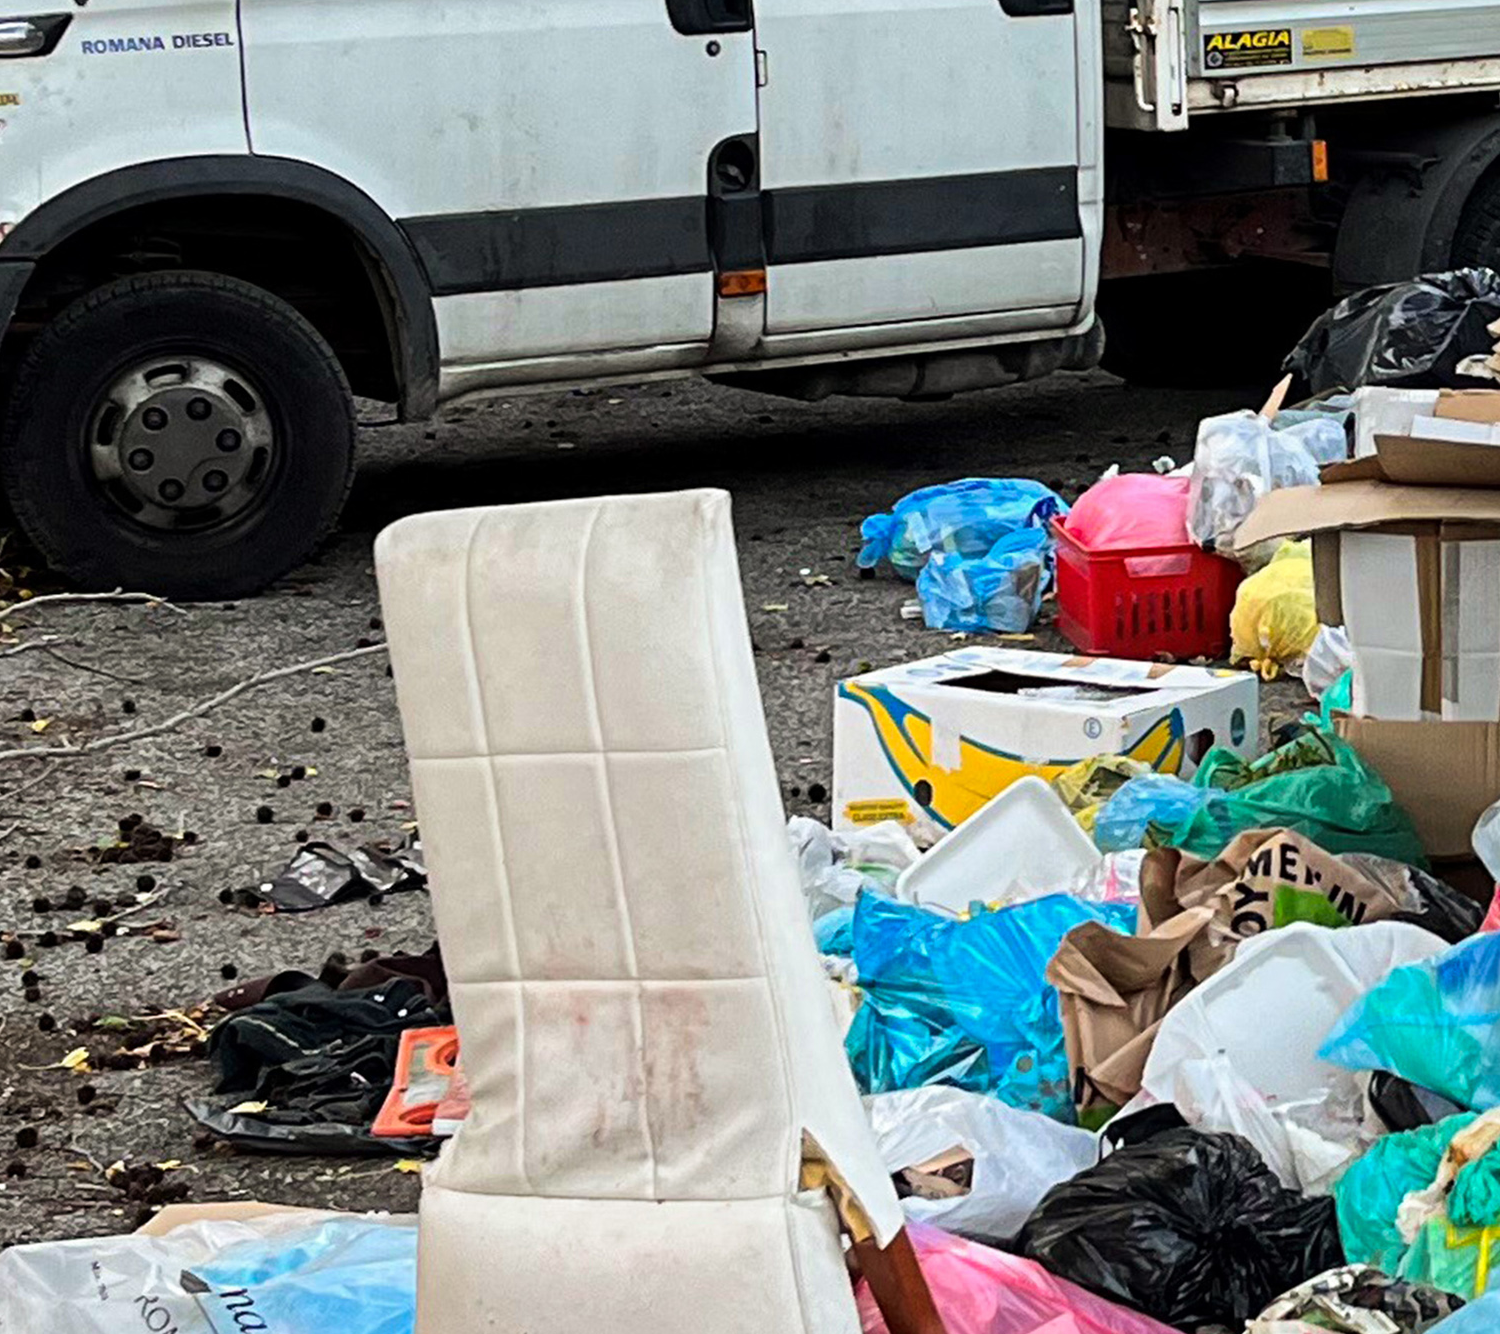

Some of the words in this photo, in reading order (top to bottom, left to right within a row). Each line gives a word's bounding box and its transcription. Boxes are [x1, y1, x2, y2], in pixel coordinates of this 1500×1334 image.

[81, 36, 165, 55] ROMANA
[172, 33, 235, 50] DIESEL
[1207, 31, 1290, 51] ALAGIA
